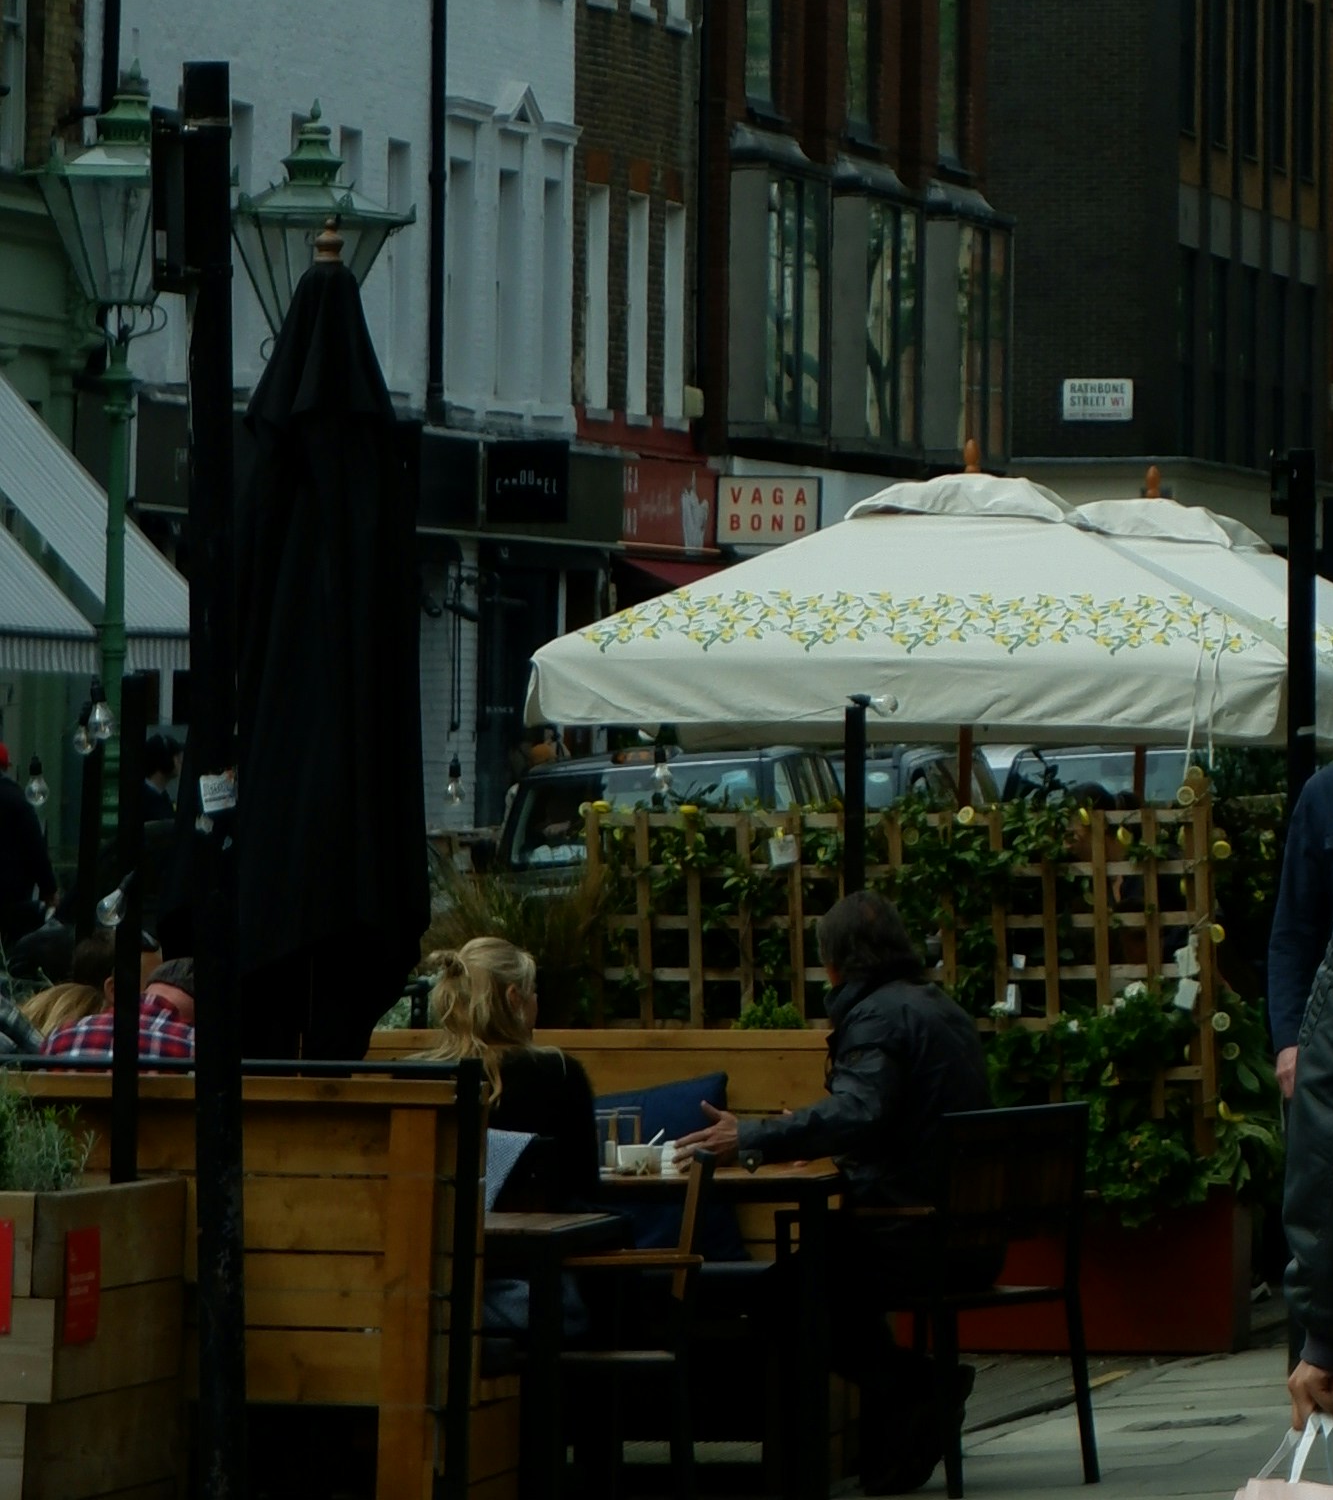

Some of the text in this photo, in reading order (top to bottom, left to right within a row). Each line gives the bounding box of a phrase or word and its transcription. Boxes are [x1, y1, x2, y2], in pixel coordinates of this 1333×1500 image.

[1069, 382, 1126, 394] RATHBONE
[1069, 395, 1106, 407] STREET
[729, 486, 808, 506] VAGA
[729, 513, 807, 533] BOND
